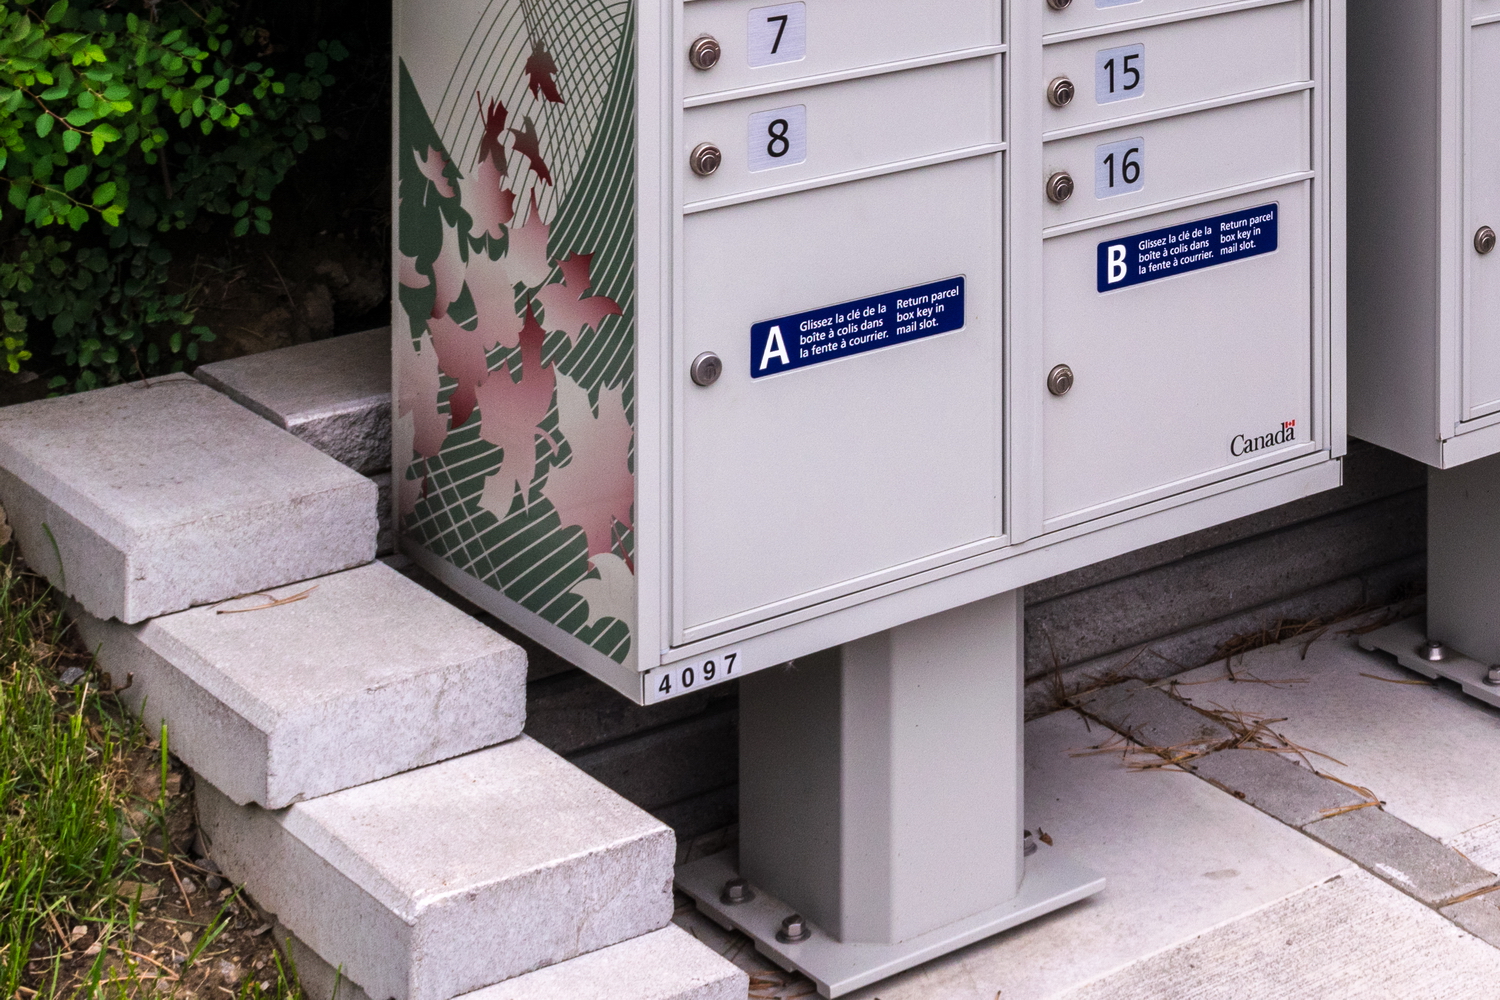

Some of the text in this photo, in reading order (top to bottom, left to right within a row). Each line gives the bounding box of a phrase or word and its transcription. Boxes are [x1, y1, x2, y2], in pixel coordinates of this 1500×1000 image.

[767, 14, 788, 55] 7
[1103, 53, 1140, 93] 15
[767, 118, 790, 158] 8
[1103, 147, 1140, 188] 16
[1220, 211, 1273, 231] Return parcel
[1108, 244, 1127, 284] B
[897, 286, 959, 309] Return parcel
[897, 303, 944, 322] box key in
[800, 304, 886, 331] Glissez la clé de la
[800, 319, 883, 345] boîte à colis dans
[897, 318, 938, 335] mail slot.
[759, 325, 790, 370] A
[800, 331, 888, 358] la fente à courrier.
[1230, 419, 1295, 457] Canada
[658, 652, 737, 694] 4097
